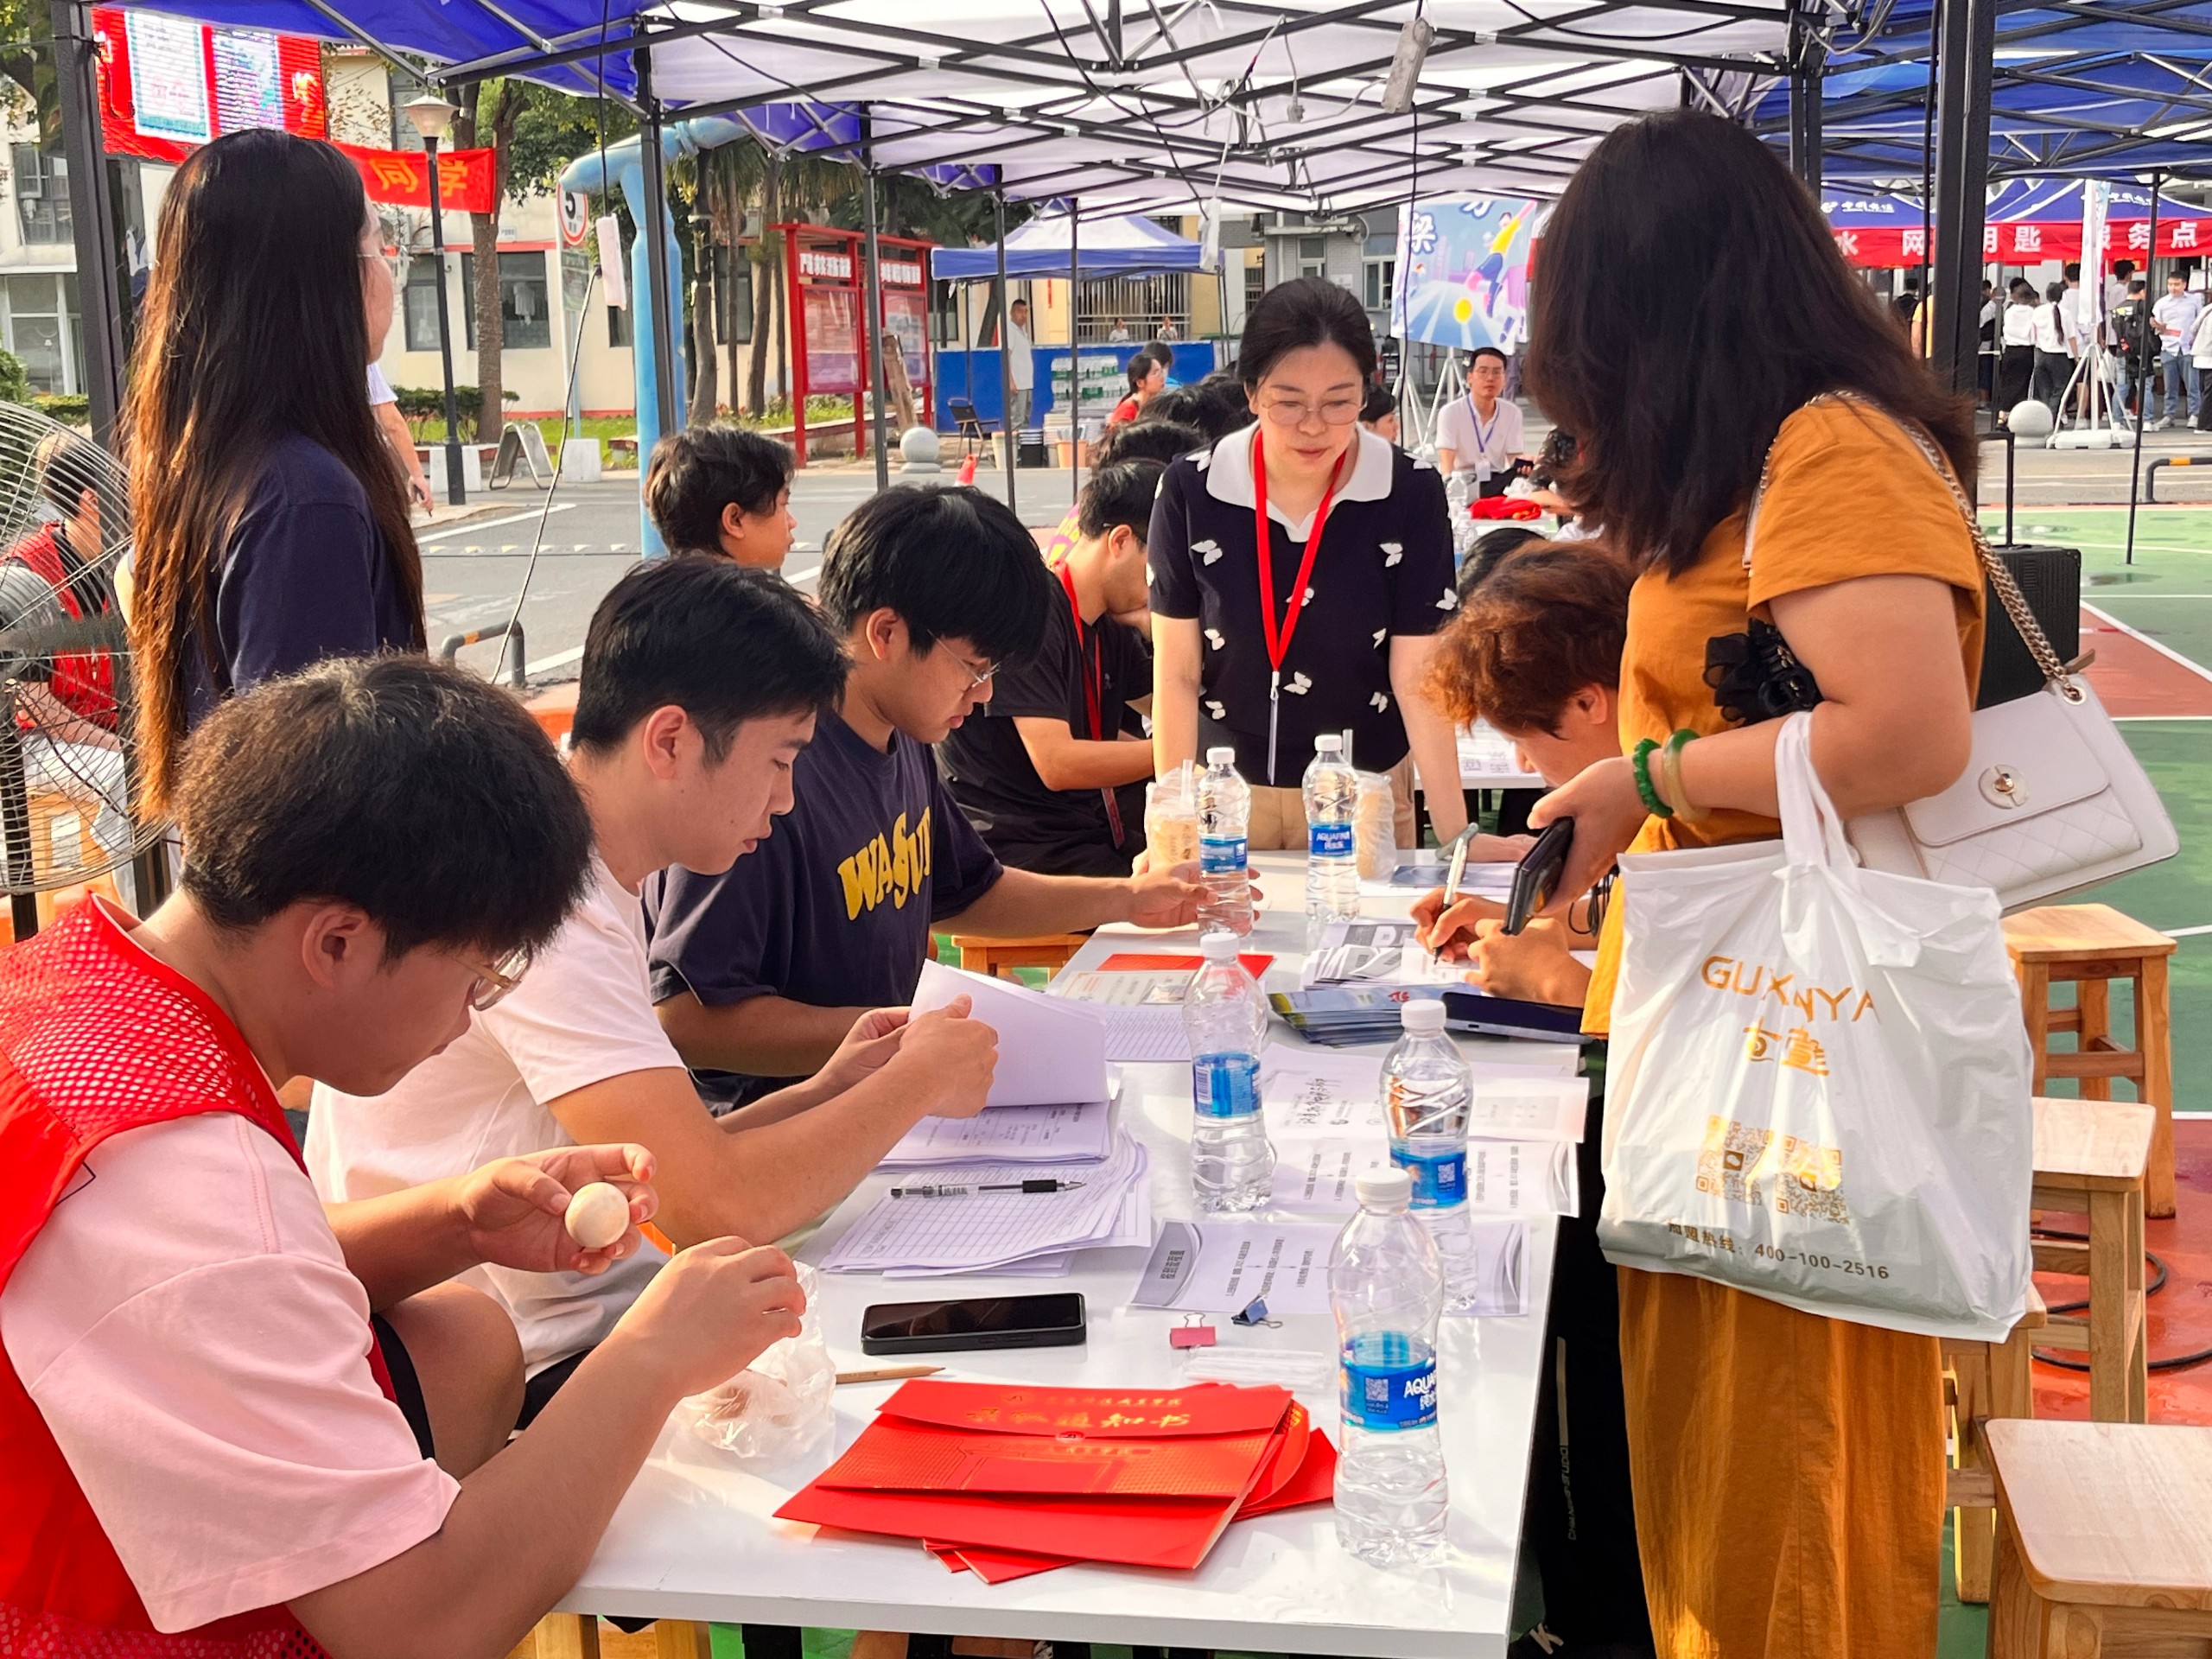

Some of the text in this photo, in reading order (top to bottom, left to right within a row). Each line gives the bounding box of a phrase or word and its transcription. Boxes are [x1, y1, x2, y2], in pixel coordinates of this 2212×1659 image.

[369, 157, 468, 198] 同学
[565, 190, 576, 215] 5
[1405, 212, 1436, 252] 梁
[1754, 1243, 1890, 1280] 400-100-2516
